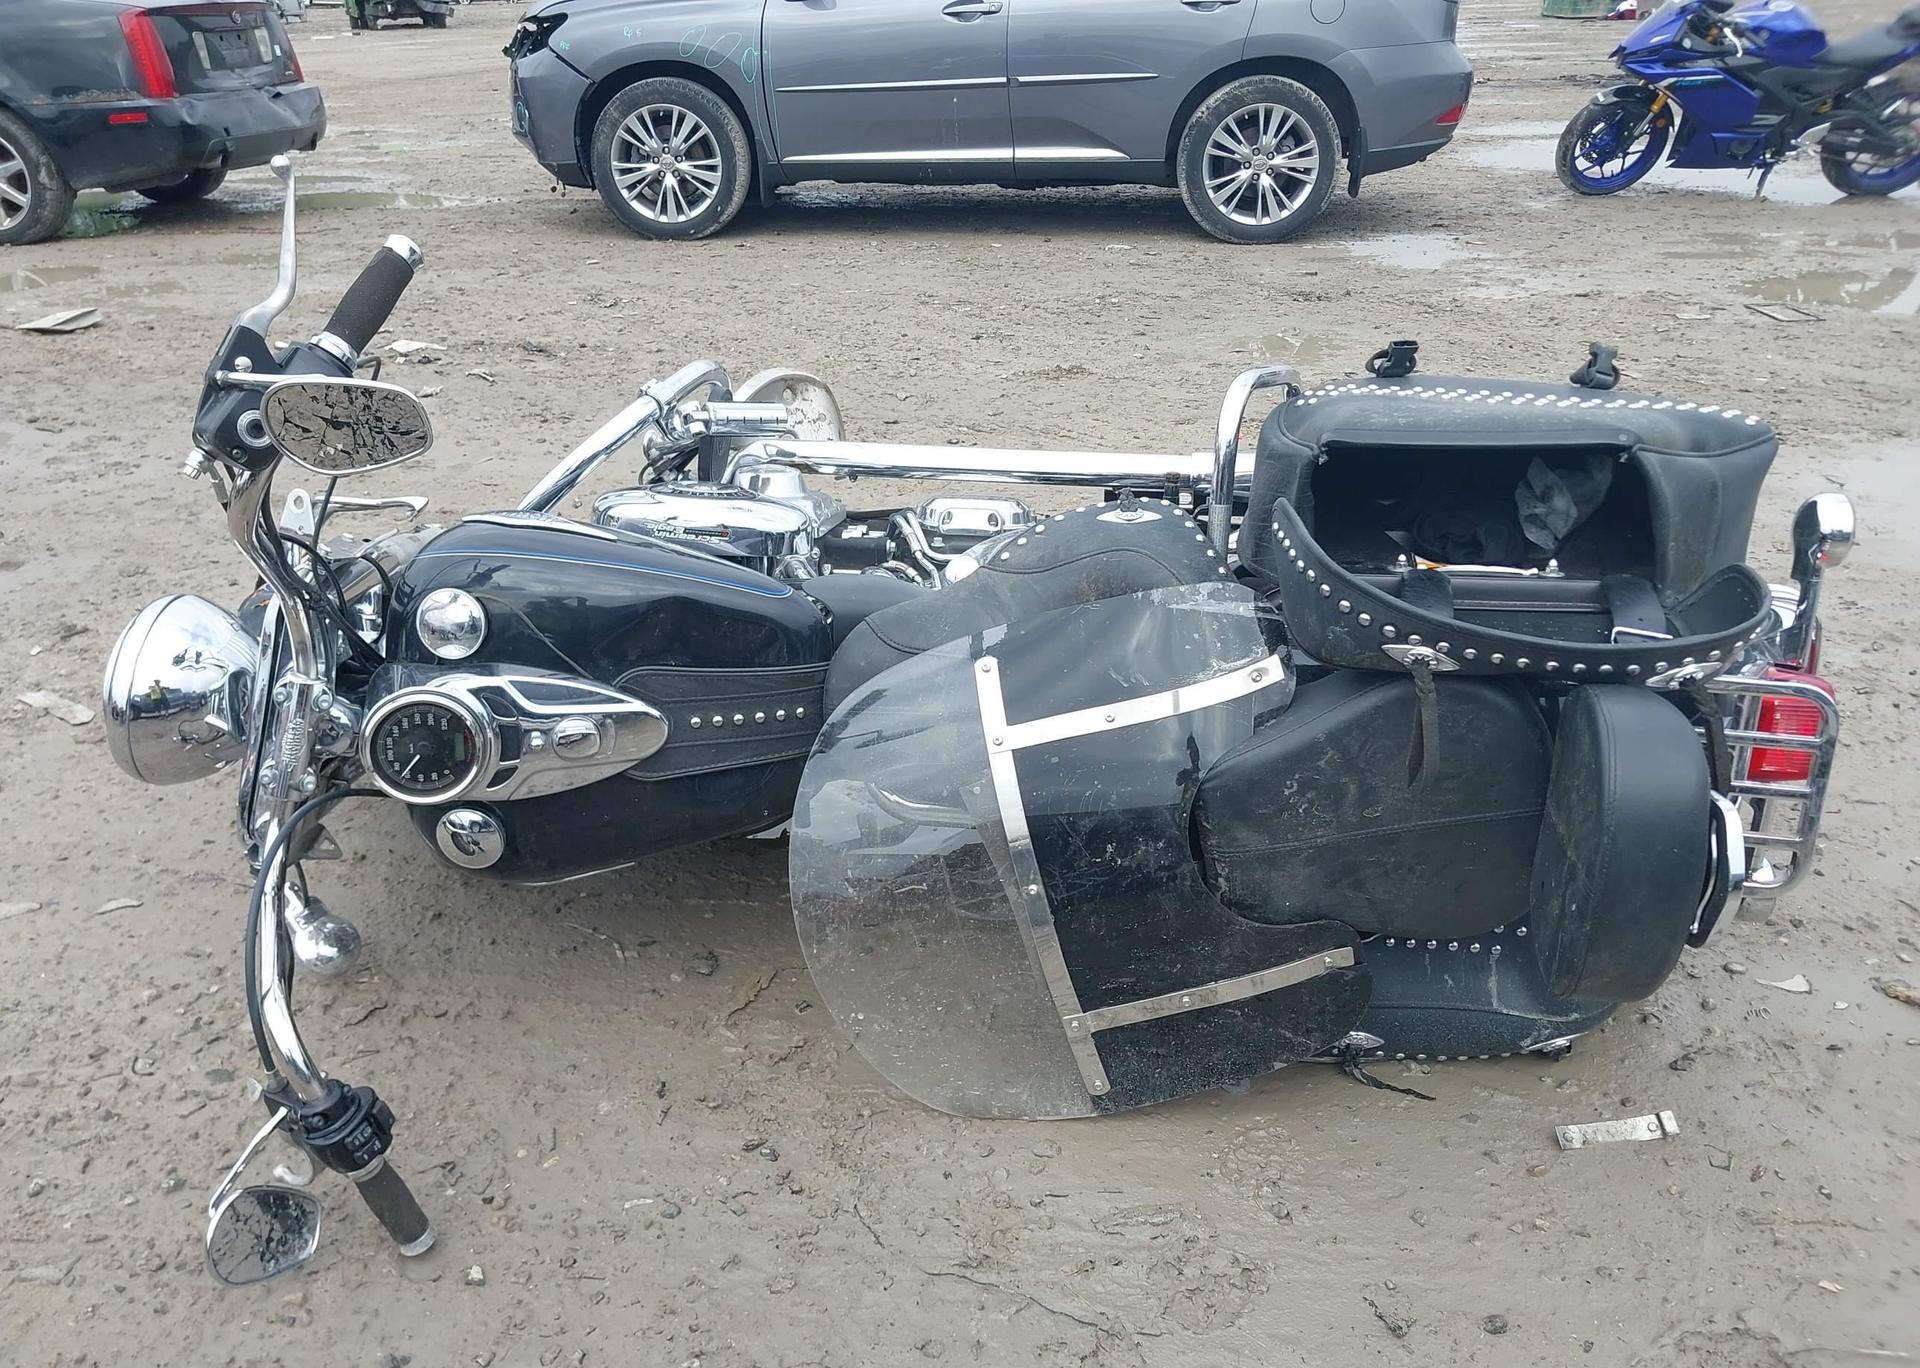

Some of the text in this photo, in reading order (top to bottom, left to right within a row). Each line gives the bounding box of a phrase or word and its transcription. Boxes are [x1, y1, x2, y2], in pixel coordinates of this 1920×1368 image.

[644, 522, 686, 534] Eagle
[386, 737, 394, 749] 120
[393, 762, 401, 771] 80
[417, 774, 425, 782] 40
